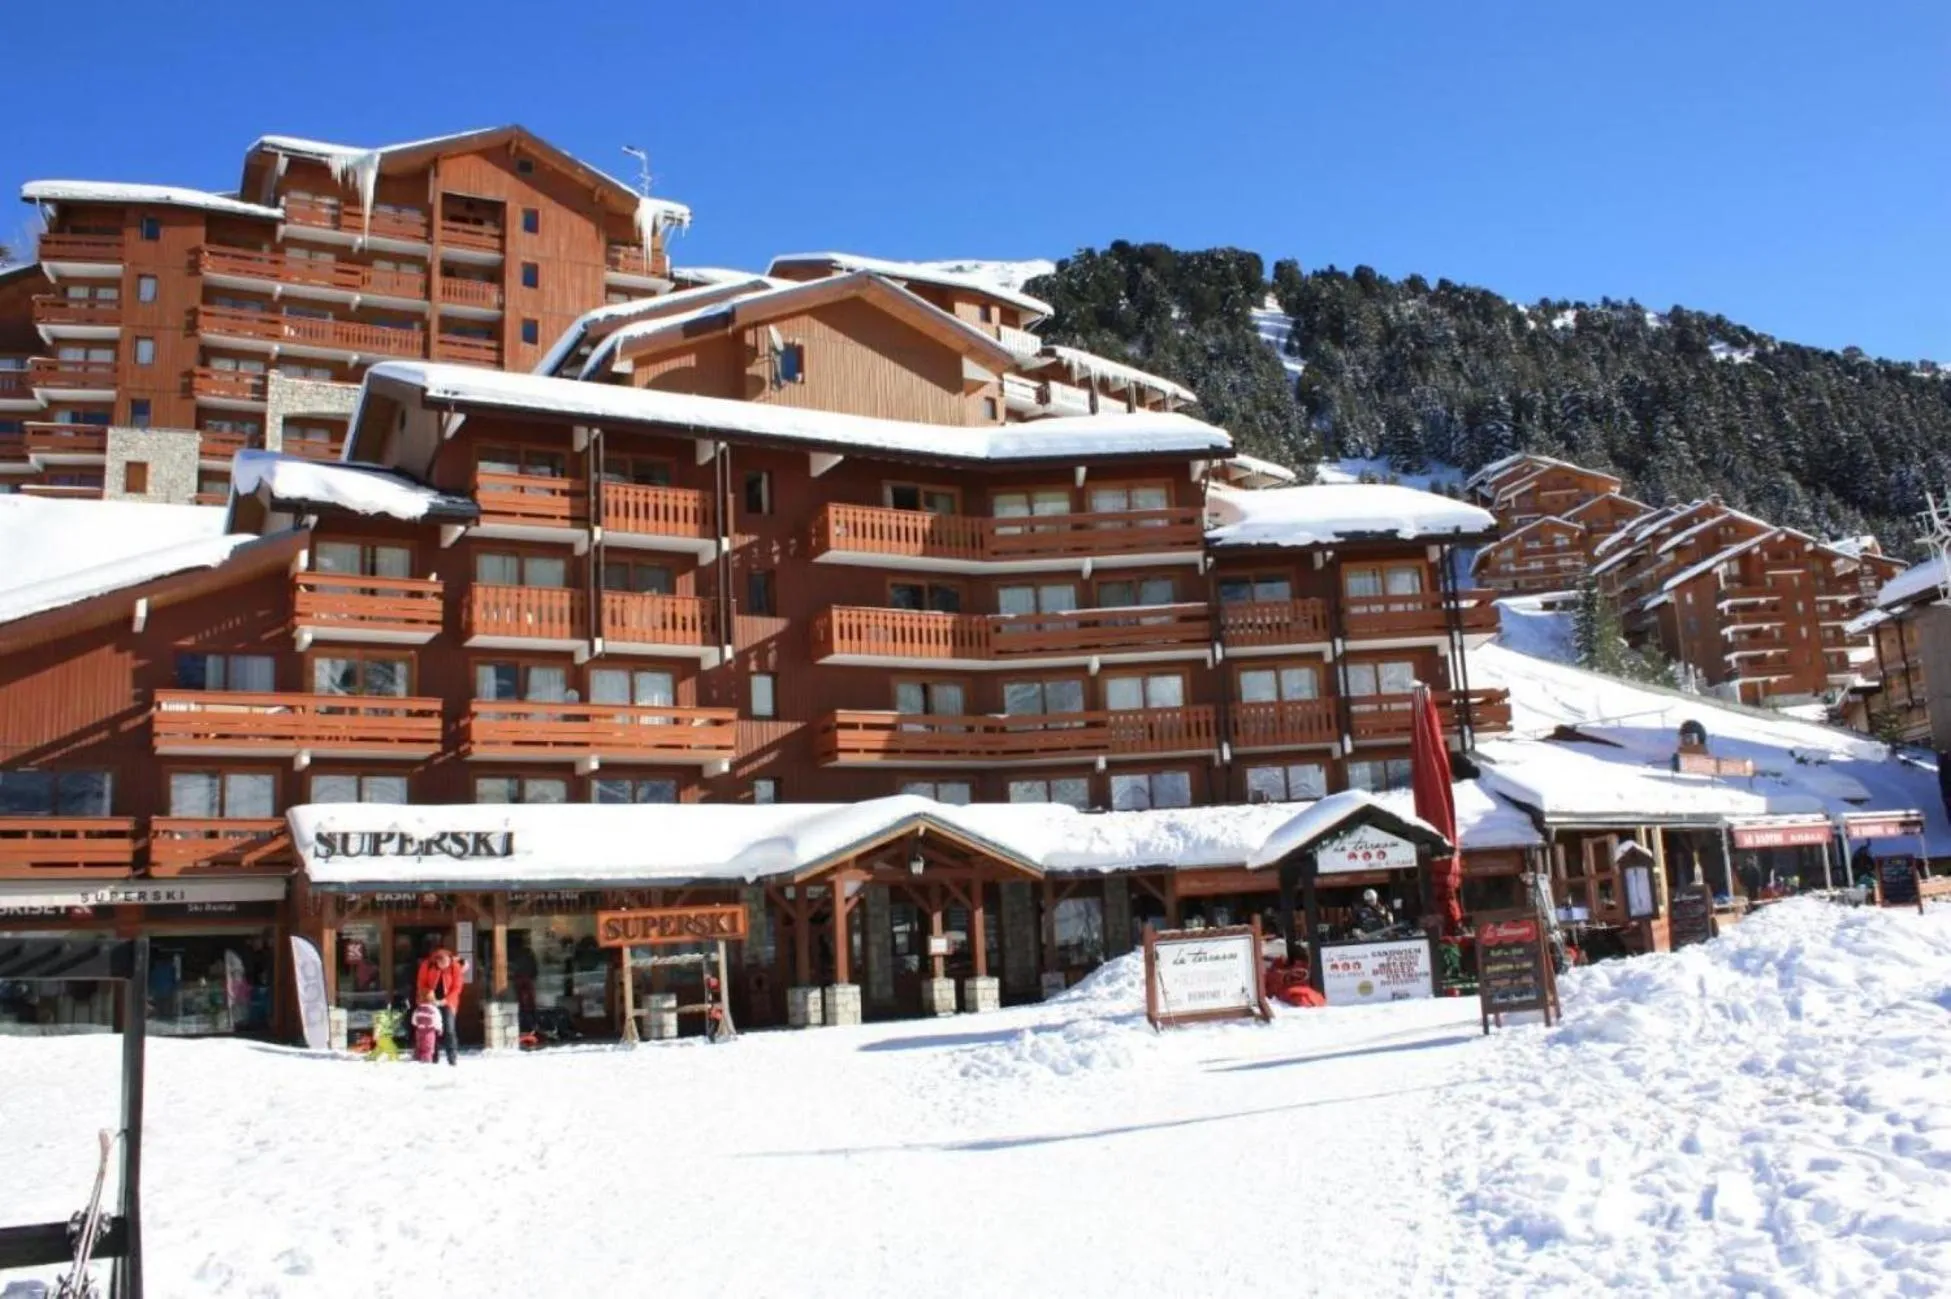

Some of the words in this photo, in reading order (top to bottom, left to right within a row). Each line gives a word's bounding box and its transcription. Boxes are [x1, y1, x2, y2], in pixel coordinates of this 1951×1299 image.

[313, 831, 514, 861] SUPERSKI
[80, 890, 186, 903] SUPERSKI
[605, 911, 739, 940] SUPERSKI
